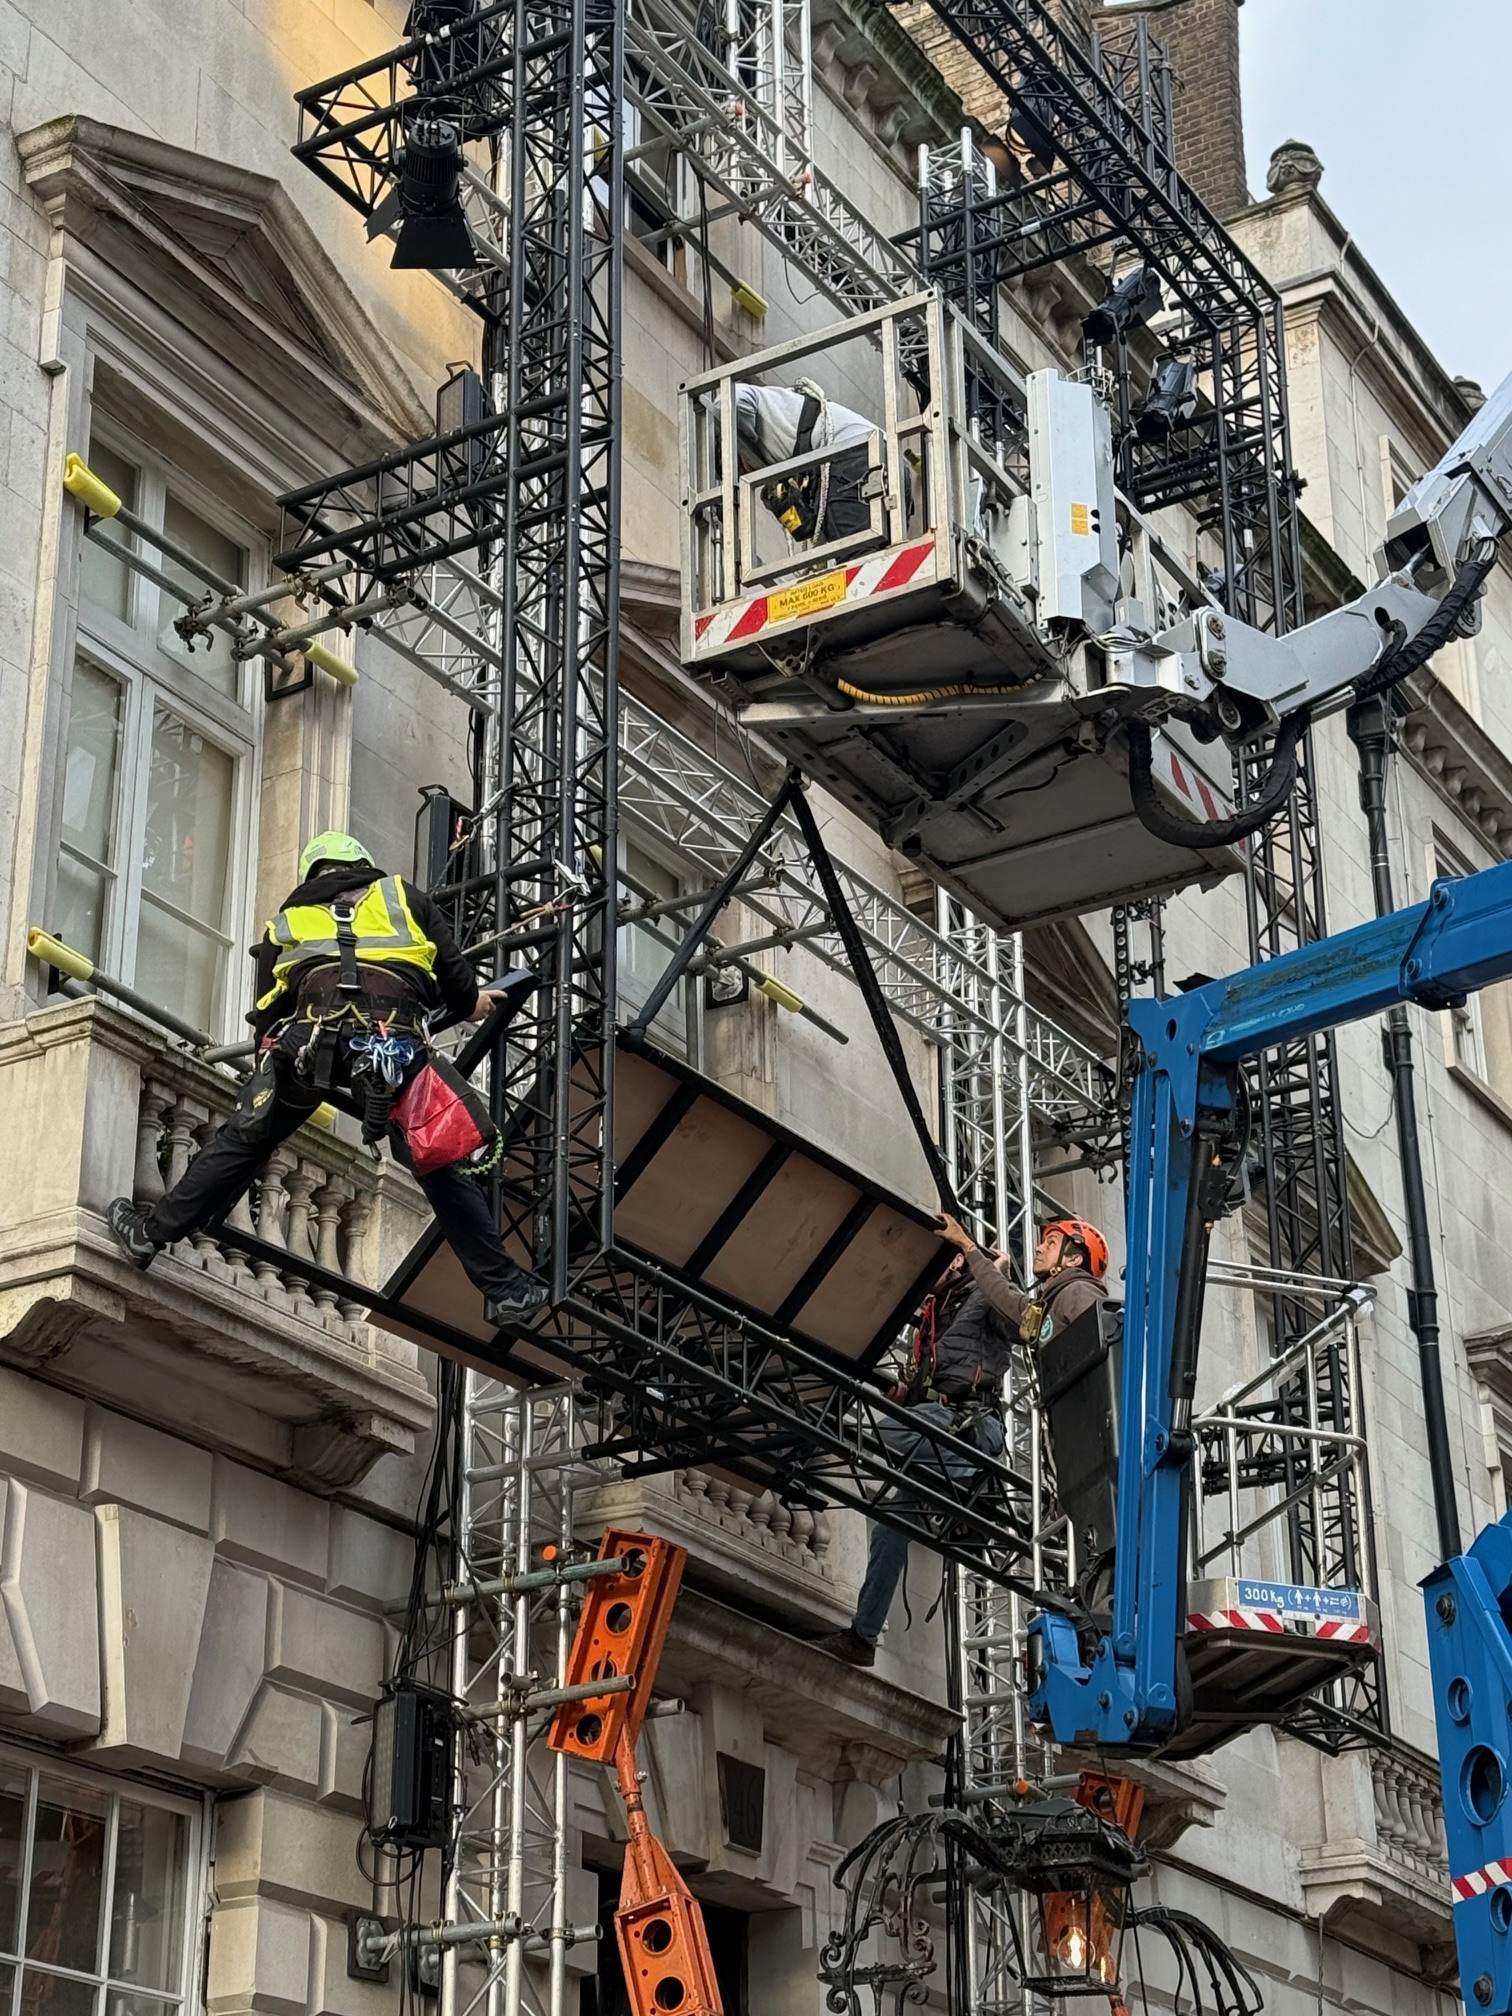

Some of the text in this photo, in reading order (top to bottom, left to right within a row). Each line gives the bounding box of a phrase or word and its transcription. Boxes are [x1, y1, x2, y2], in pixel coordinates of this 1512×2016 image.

[779, 594, 801, 607] MAX
[802, 588, 819, 600] 600
[820, 583, 835, 595] KG
[733, 1767, 758, 1840] 46
